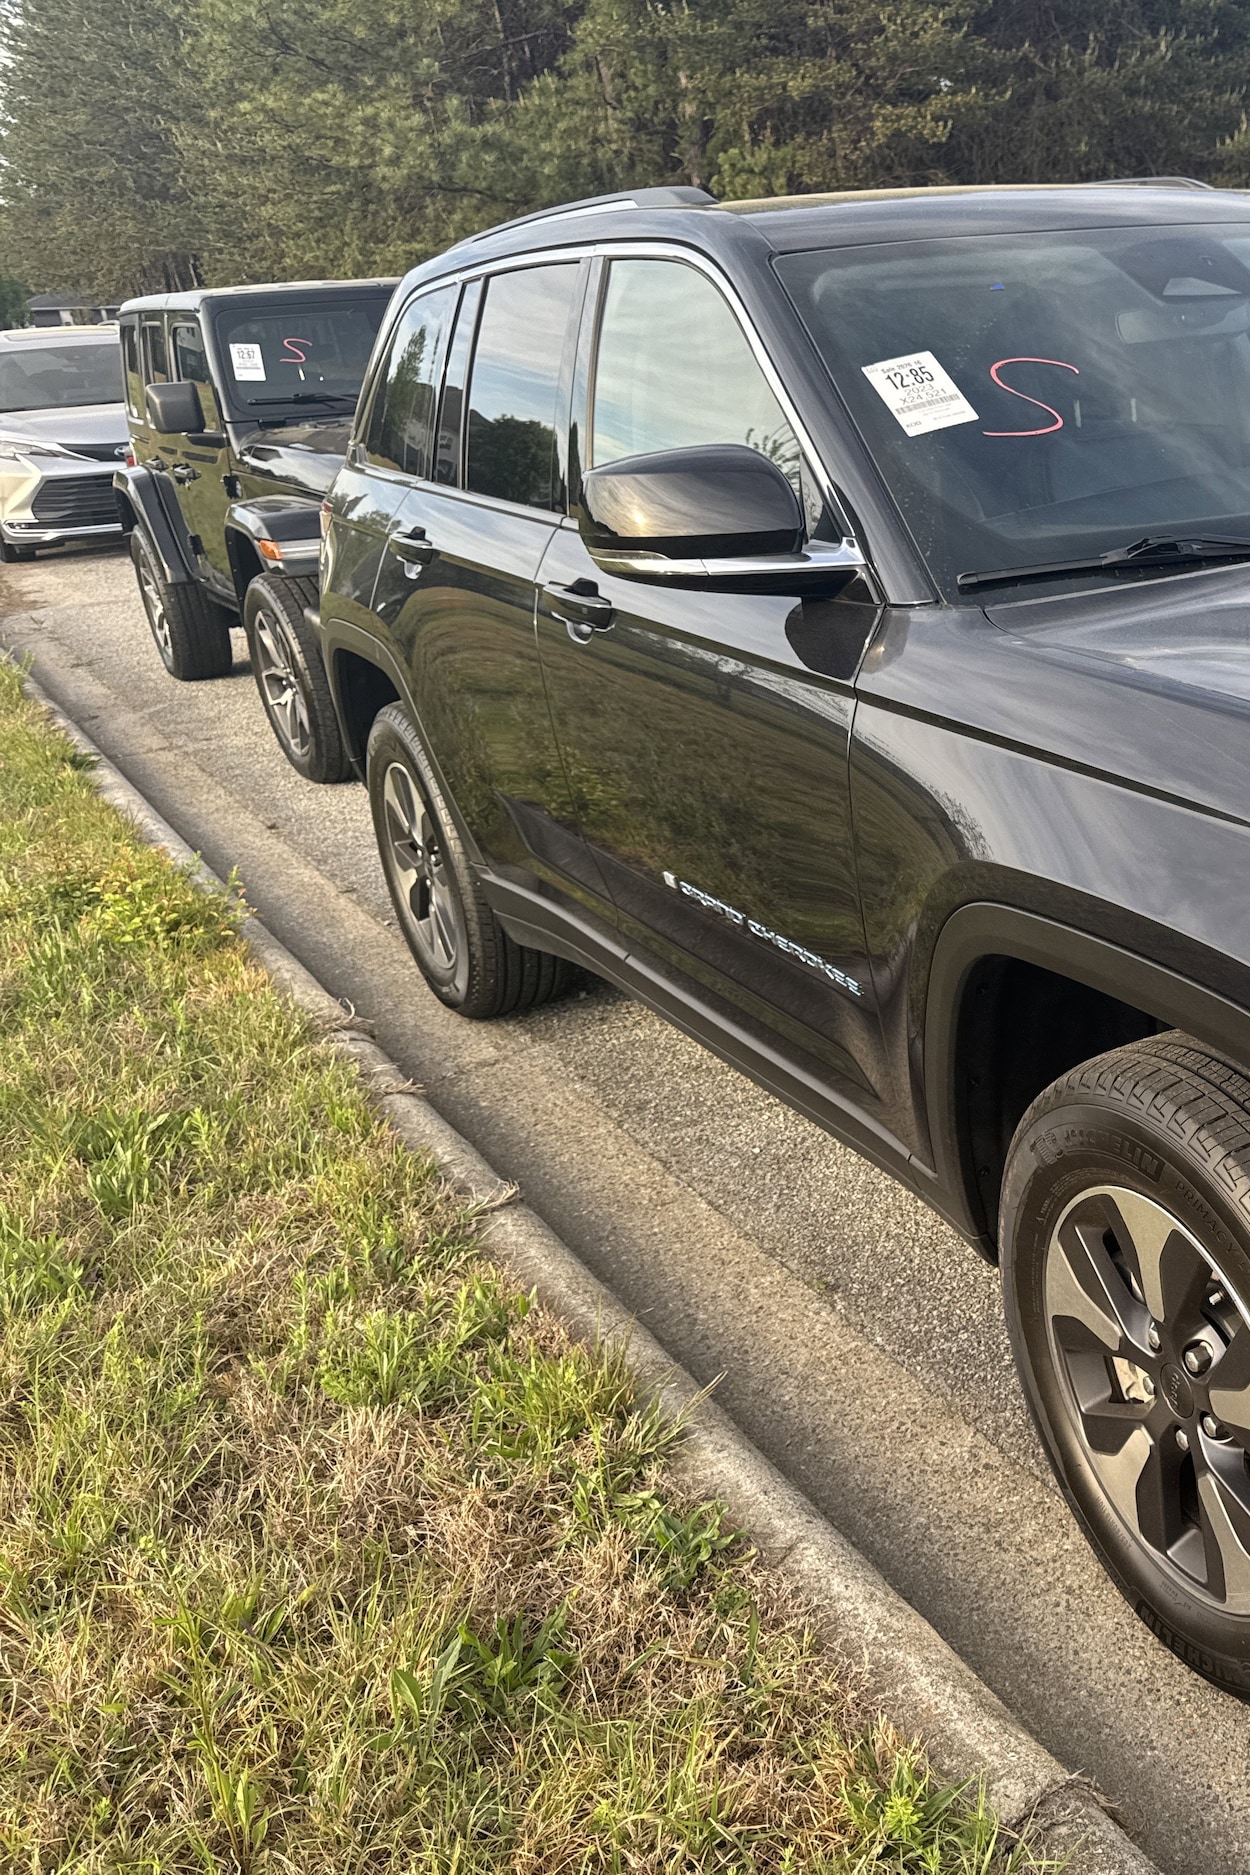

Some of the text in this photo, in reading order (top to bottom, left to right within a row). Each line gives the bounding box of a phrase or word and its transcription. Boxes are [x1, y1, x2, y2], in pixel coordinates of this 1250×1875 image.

[280, 338, 313, 363] S
[885, 365, 935, 390] 12:85
[904, 383, 935, 396] 2023
[982, 357, 1080, 437] S
[747, 919, 865, 996] CHEROKEE
[1175, 1181, 1238, 1254] PRIMACY
[1139, 1603, 1243, 1684] MICHELIN
